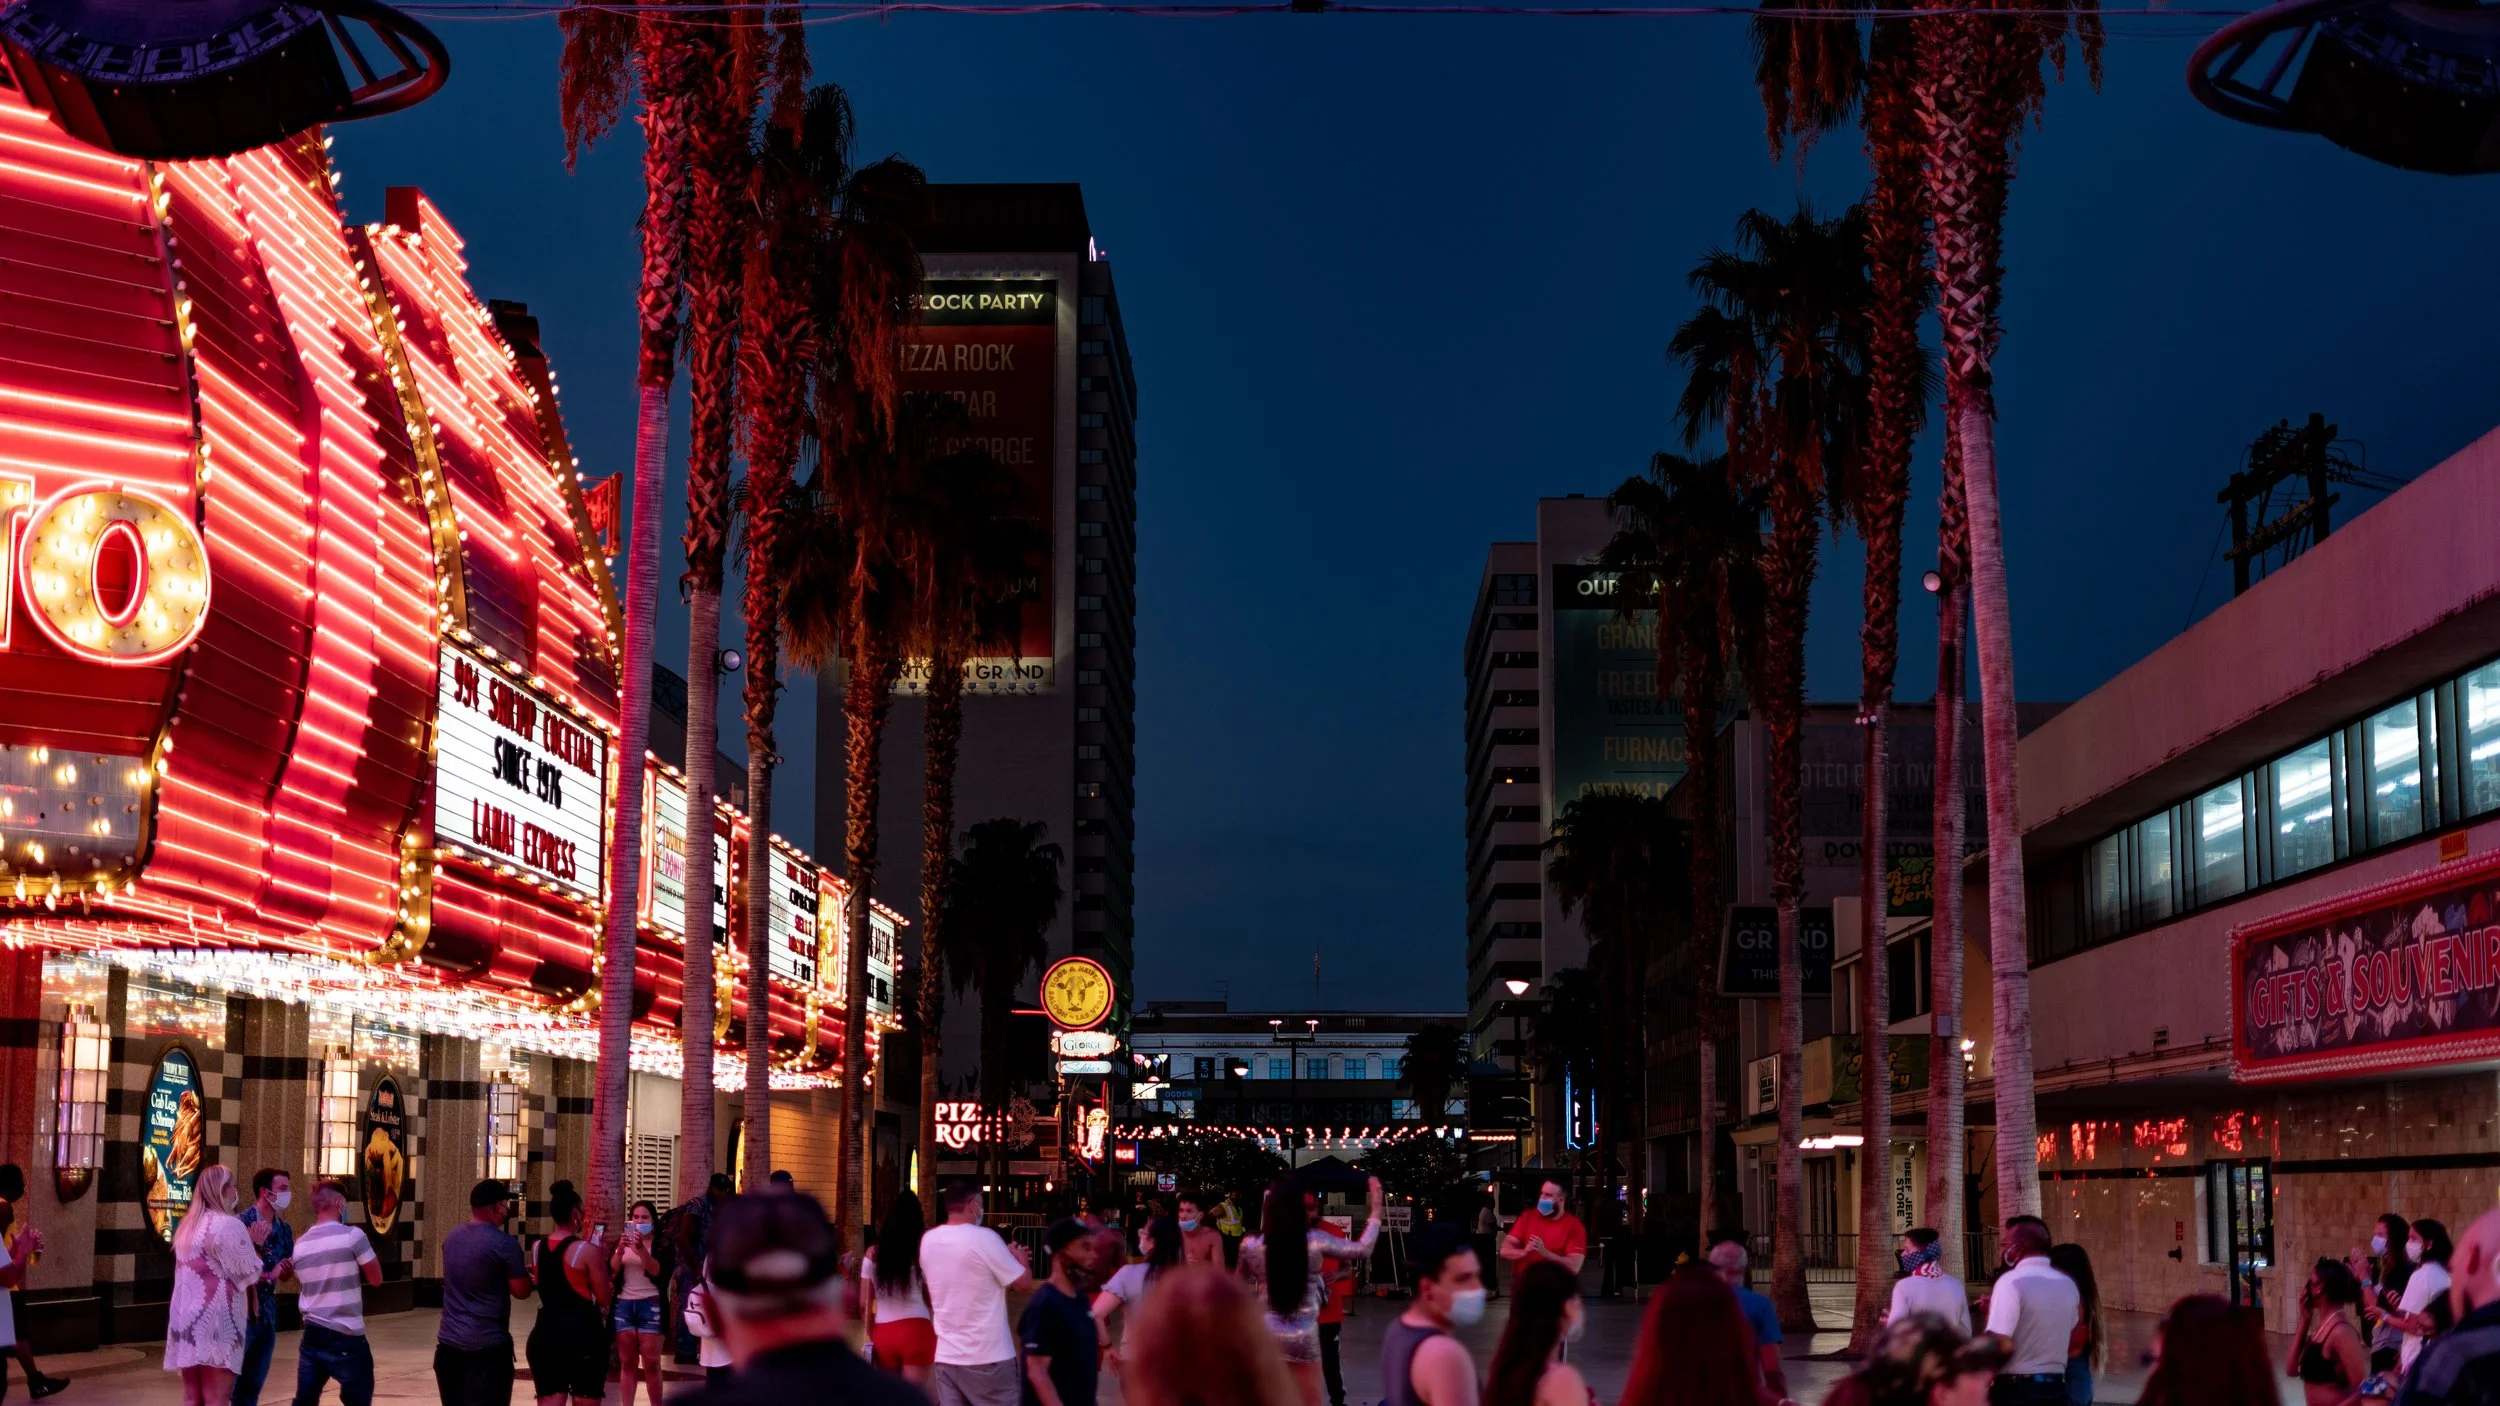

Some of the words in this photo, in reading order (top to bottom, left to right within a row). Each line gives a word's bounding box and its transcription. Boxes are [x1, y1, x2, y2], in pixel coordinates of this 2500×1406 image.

[912, 294, 975, 310] LOCK
[979, 294, 1044, 310] PARTY
[900, 344, 948, 371] IZZA
[954, 344, 1015, 371] ROCK
[1607, 700, 1651, 715] TASTES
[1653, 701, 1665, 715] &
[487, 676, 538, 743] SHRIMP
[542, 709, 597, 778] COCKTAIL
[1604, 736, 1688, 762] FURNAC
[491, 734, 532, 795] SINCE
[1801, 763, 1848, 788] OTED
[522, 820, 576, 883] EXPRESS
[1891, 884, 1935, 908] Jerk
[1736, 929, 1829, 950] GRND
[2252, 965, 2321, 1029] GIFTS
[2326, 960, 2347, 1017] &
[1164, 1090, 1194, 1098] OGDEN
[1904, 1161, 1913, 1193] BEEF
[1895, 1177, 1905, 1217] STORE
[1904, 1197, 1914, 1228] JERK
